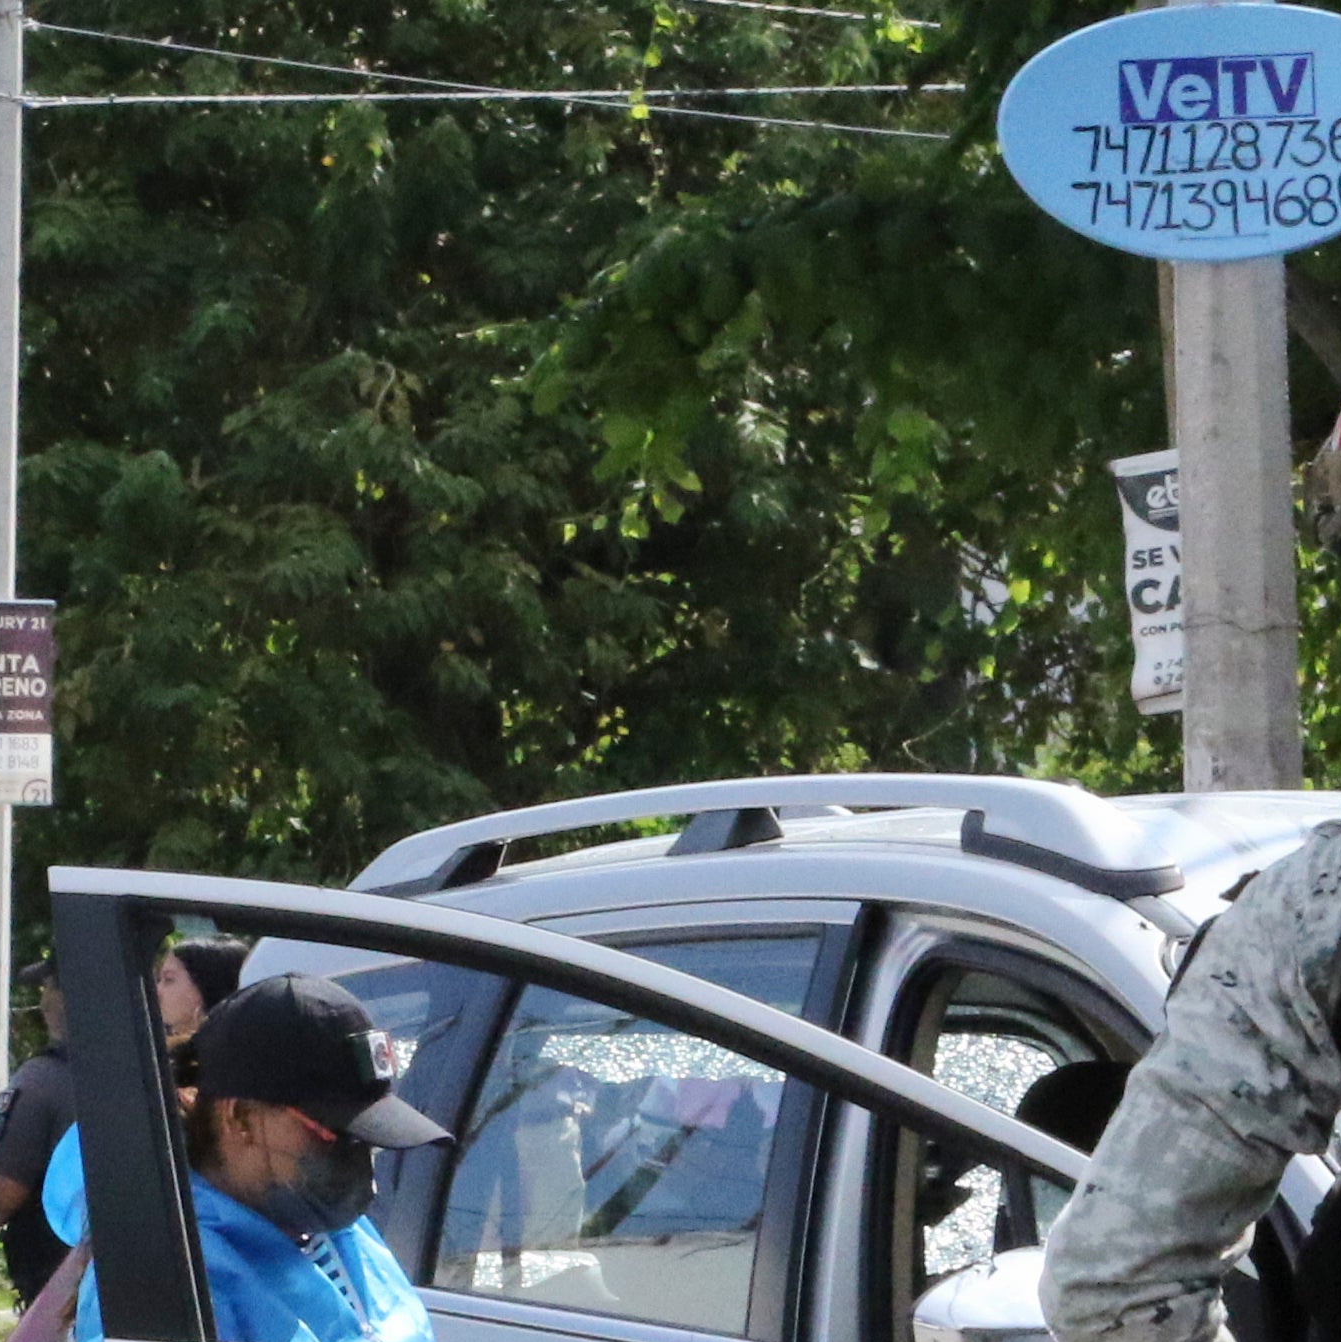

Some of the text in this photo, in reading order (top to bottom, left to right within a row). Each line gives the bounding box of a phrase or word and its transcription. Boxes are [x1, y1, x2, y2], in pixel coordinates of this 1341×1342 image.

[1121, 55, 1310, 122] VeTV
[1132, 547, 1164, 570] SE
[30, 616, 47, 631] 21
[1140, 624, 1167, 637] CON
[6, 709, 45, 721] ZONA
